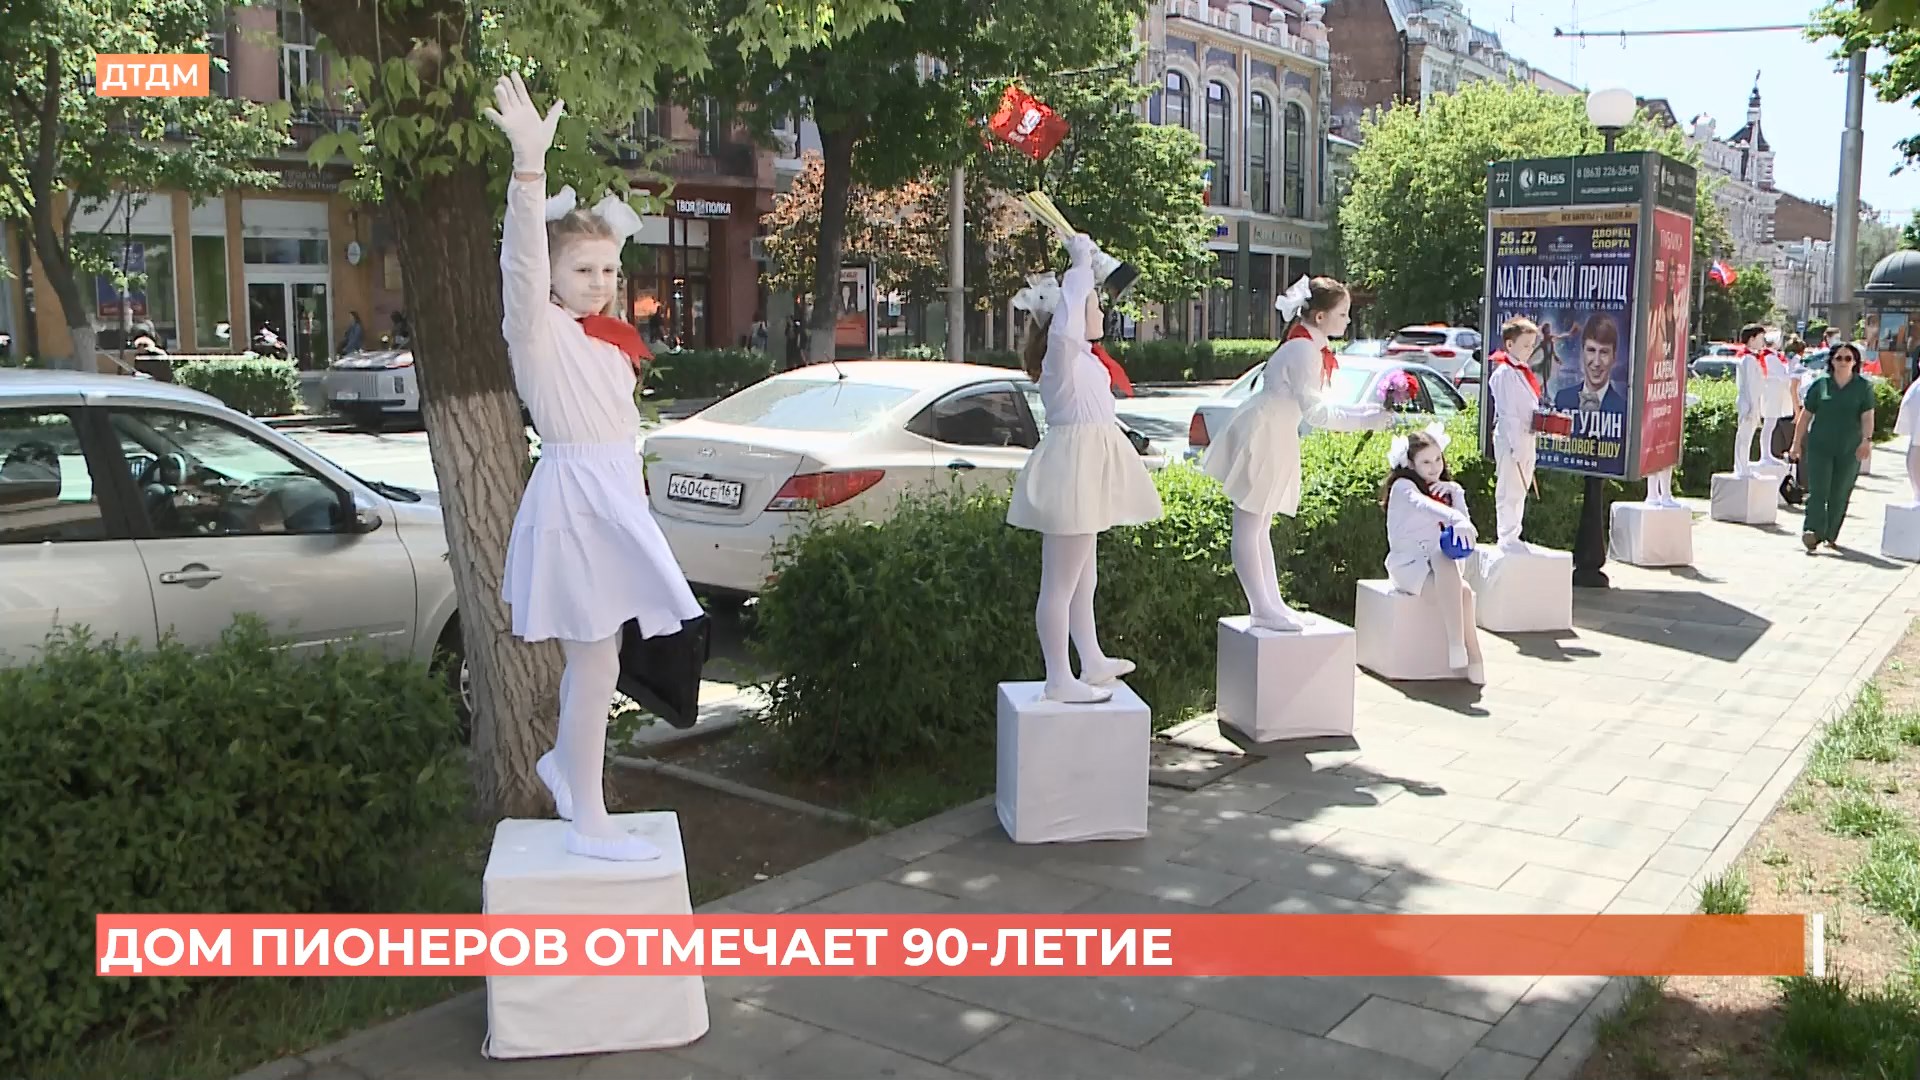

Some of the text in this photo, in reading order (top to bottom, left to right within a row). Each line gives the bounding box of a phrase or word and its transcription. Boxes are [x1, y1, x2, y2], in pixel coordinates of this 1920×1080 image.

[1495, 172, 1510, 183] 222
[1537, 171, 1566, 185] Russ
[676, 199, 732, 214] ТВОЯ ПОЛКА
[1499, 231, 1537, 245] 26.27
[1591, 228, 1631, 239] ДВОРЕЦ
[1591, 239, 1630, 249] СПОРТА
[1497, 246, 1538, 257] ДЕКАБРЯ
[1496, 261, 1575, 299] МАЛЕНЬКИЙ
[1578, 265, 1628, 303] ПРИНЦ
[1573, 302, 1624, 310] СПЕКТАКЛЬ
[1562, 409, 1622, 439] ГУДИН
[1552, 437, 1596, 456] ЛЕДОВОЕ
[1598, 441, 1620, 458] ШОУ
